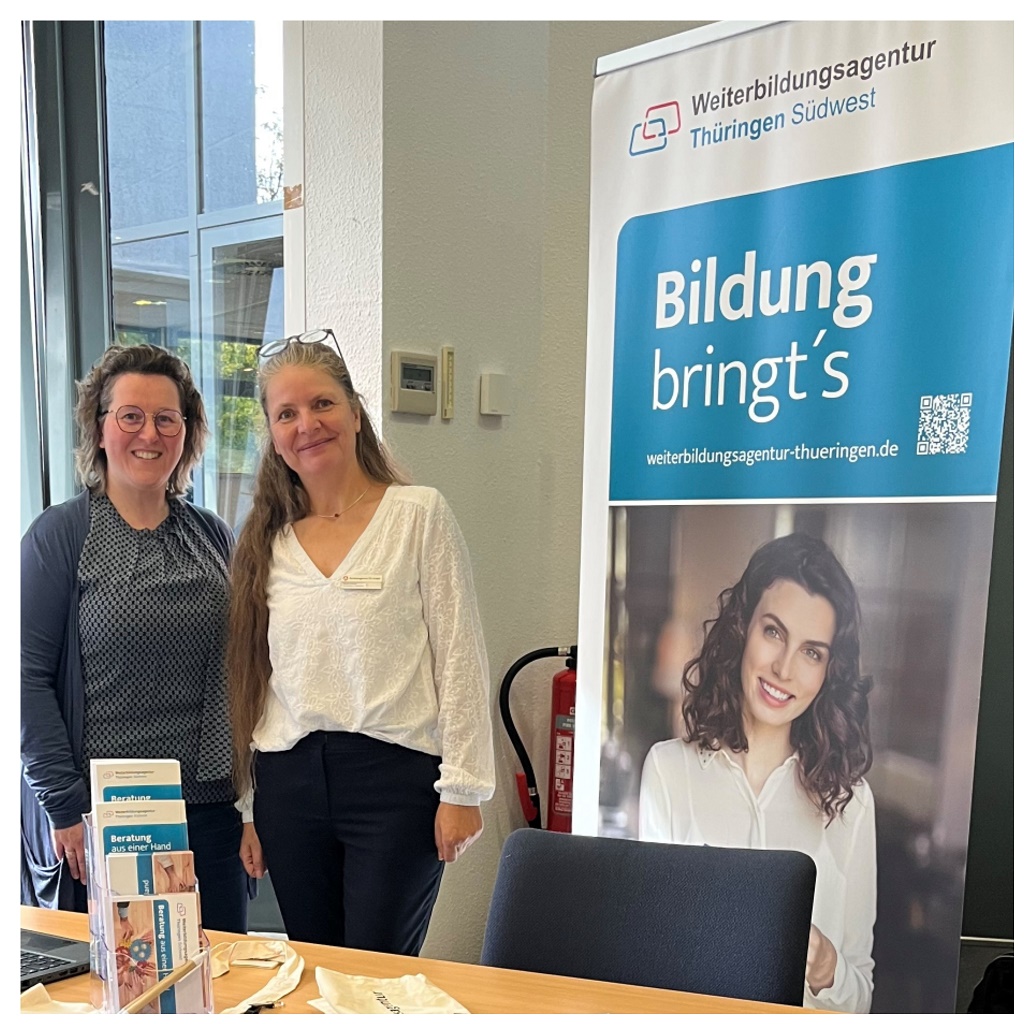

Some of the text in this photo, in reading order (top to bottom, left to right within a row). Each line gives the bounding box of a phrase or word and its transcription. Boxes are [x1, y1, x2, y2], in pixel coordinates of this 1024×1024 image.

[691, 37, 937, 117] Weiterbildungsagentur
[690, 87, 877, 149] Thüringen Südwest
[655, 250, 878, 329] Bildung
[646, 440, 898, 466] weiterbildungsagentur-thueringen.de
[111, 834, 152, 843] Beratung
[128, 843, 148, 851] einer
[151, 842, 171, 850] Hand
